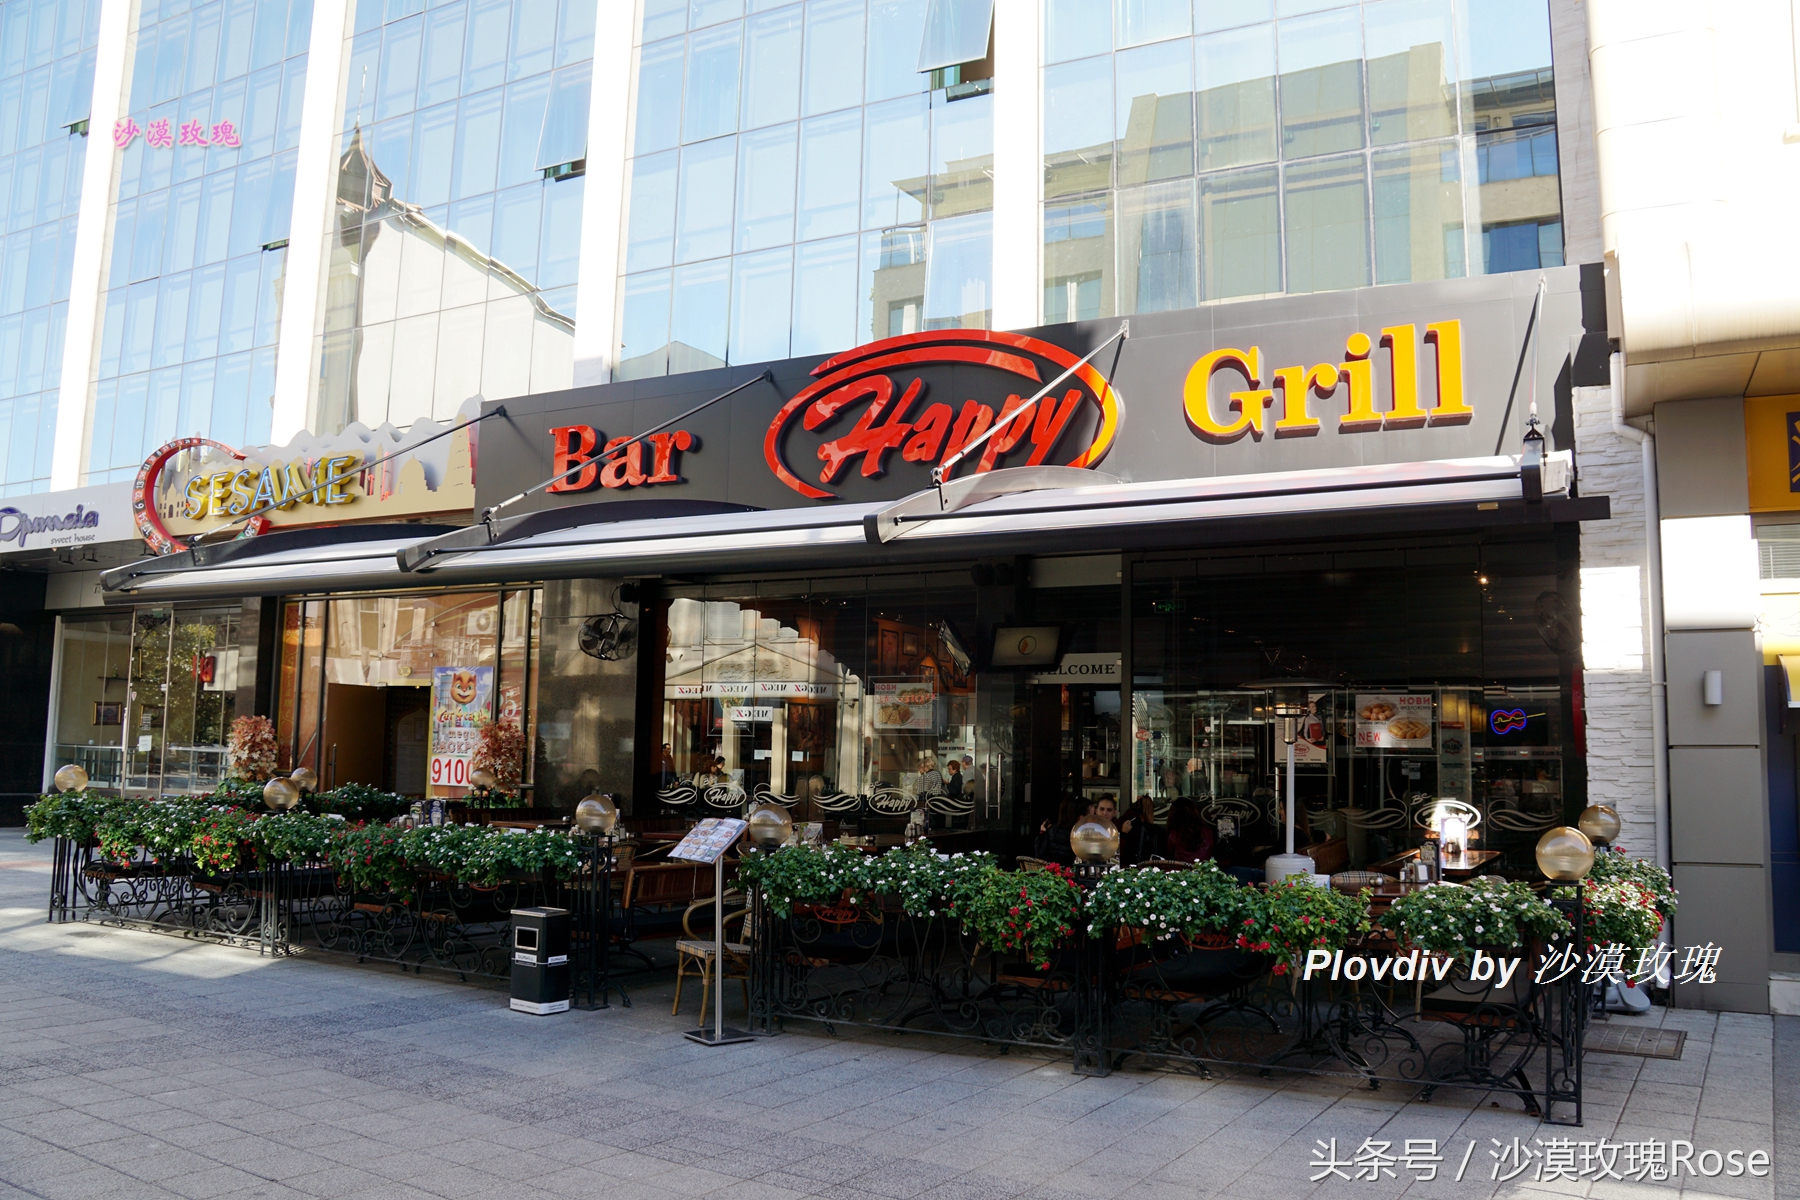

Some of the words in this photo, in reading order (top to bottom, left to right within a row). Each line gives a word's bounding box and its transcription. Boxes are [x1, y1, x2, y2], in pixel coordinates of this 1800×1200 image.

[546, 425, 693, 493] Bar
[802, 373, 1083, 484] Happy
[1183, 319, 1475, 438] Grill
[183, 455, 356, 520] SESAME
[0, 504, 99, 548] Djumaia
[50, 536, 72, 545] sweet
[74, 533, 96, 543] house
[1034, 664, 1116, 675] LCOME
[1399, 696, 1431, 705] НОВИ
[437, 708, 455, 724] Car
[1358, 731, 1381, 742] NEW
[433, 740, 480, 754] JACKPO
[709, 788, 740, 805] Happy
[874, 794, 912, 812] Happy
[821, 907, 855, 920] Happy
